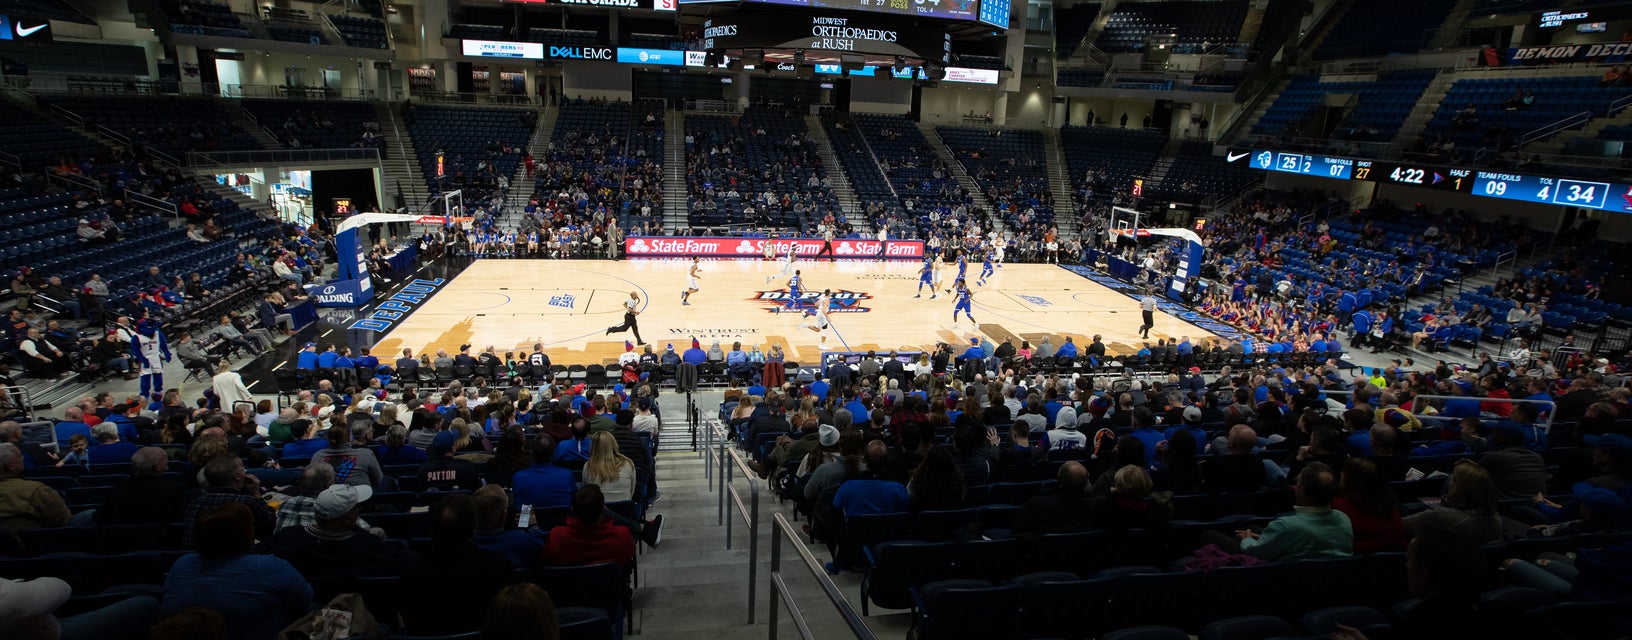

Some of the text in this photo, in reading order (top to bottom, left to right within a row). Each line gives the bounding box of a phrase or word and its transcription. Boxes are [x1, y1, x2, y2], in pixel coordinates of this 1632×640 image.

[813, 17, 847, 26] MIDWEST
[812, 26, 897, 42] ORTHOPAEDICS
[822, 38, 854, 50] RUSH
[1512, 45, 1581, 60] DEMON
[1282, 156, 1296, 169] 25
[1304, 162, 1310, 172] 2
[1330, 164, 1345, 176] 07
[1356, 168, 1370, 179] 27
[1390, 167, 1425, 184] 4:22
[1450, 169, 1470, 178] HALF
[1478, 172, 1522, 182] TEAM FOULS
[1454, 178, 1462, 190] 1
[1486, 181, 1507, 196] 09
[1536, 185, 1550, 200] 4
[1567, 185, 1594, 203] 34
[347, 278, 445, 332] DEPAUL
[428, 470, 456, 481] PAYTON
